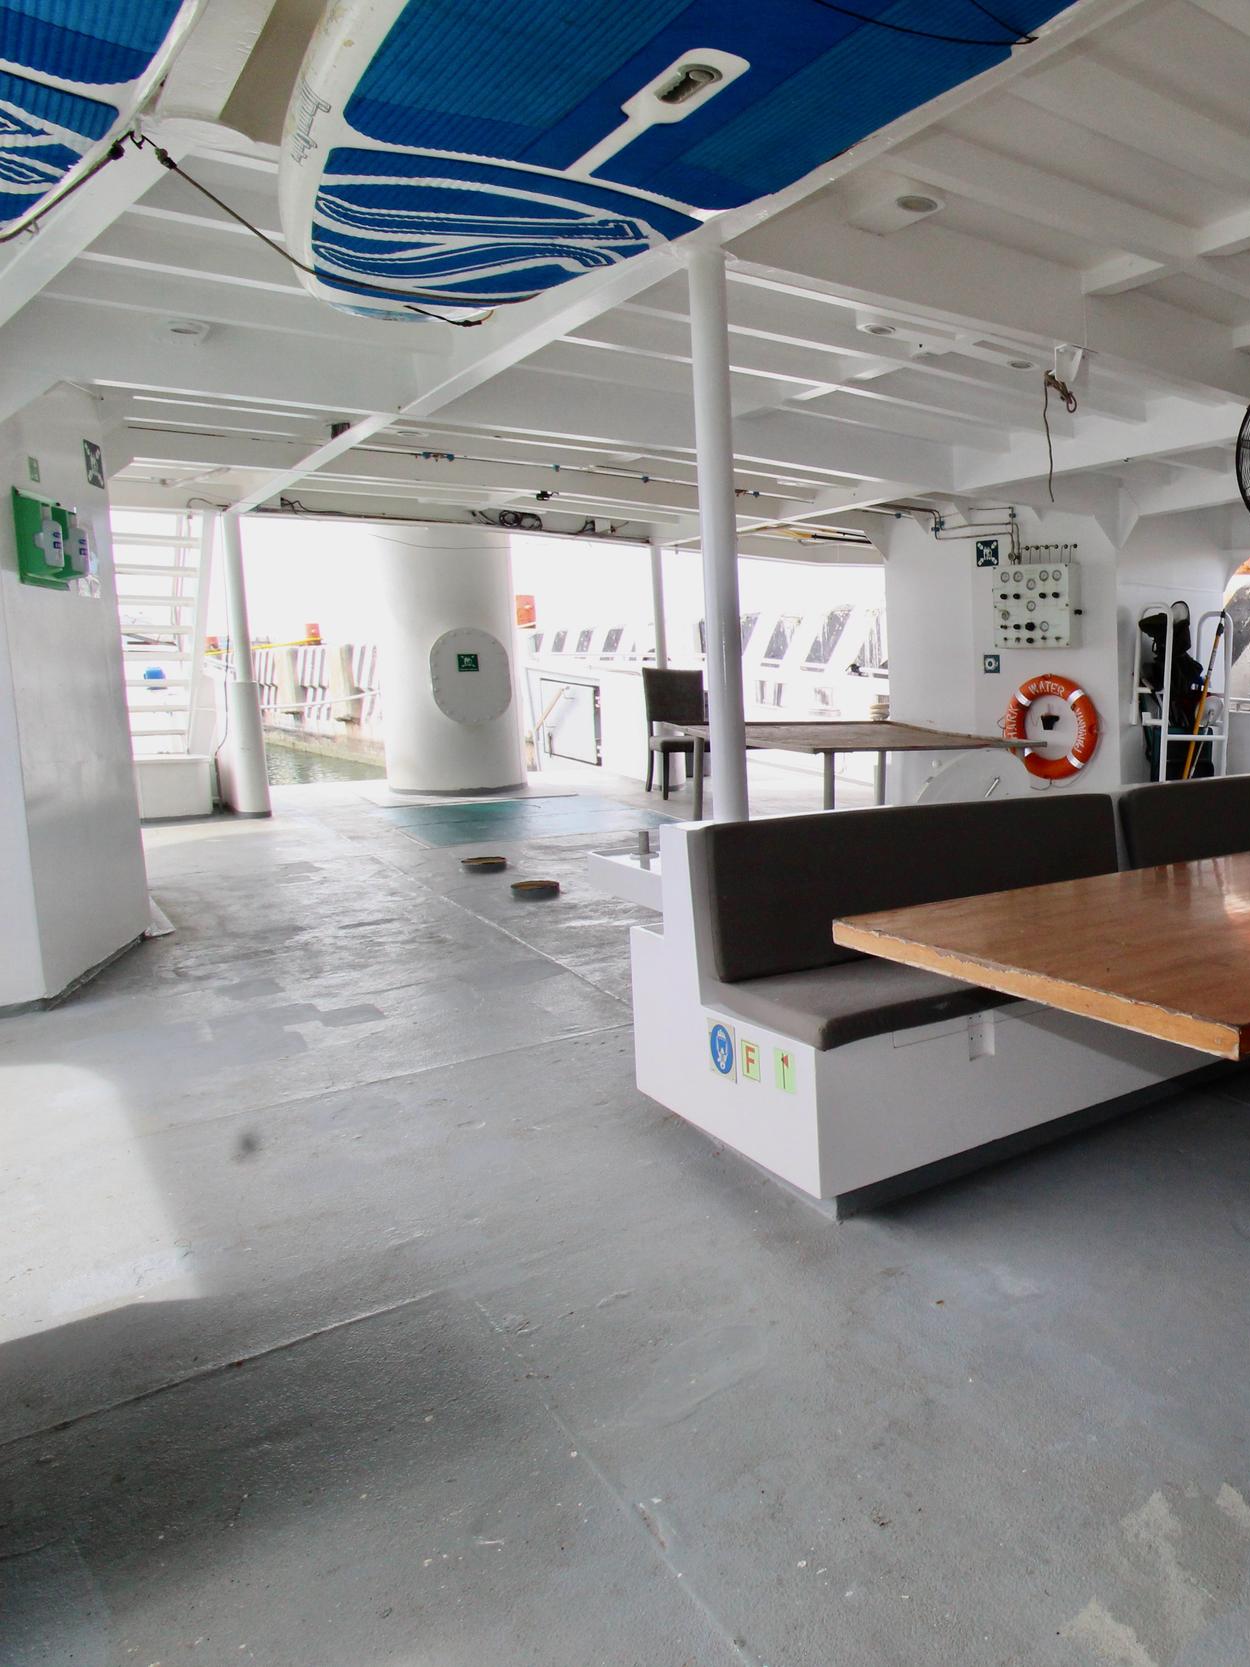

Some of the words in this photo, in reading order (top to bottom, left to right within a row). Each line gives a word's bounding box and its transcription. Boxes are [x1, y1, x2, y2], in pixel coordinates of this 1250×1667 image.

[1003, 703, 1019, 740] HARK
[1028, 680, 1066, 697] WATER
[745, 1045, 756, 1073] F
